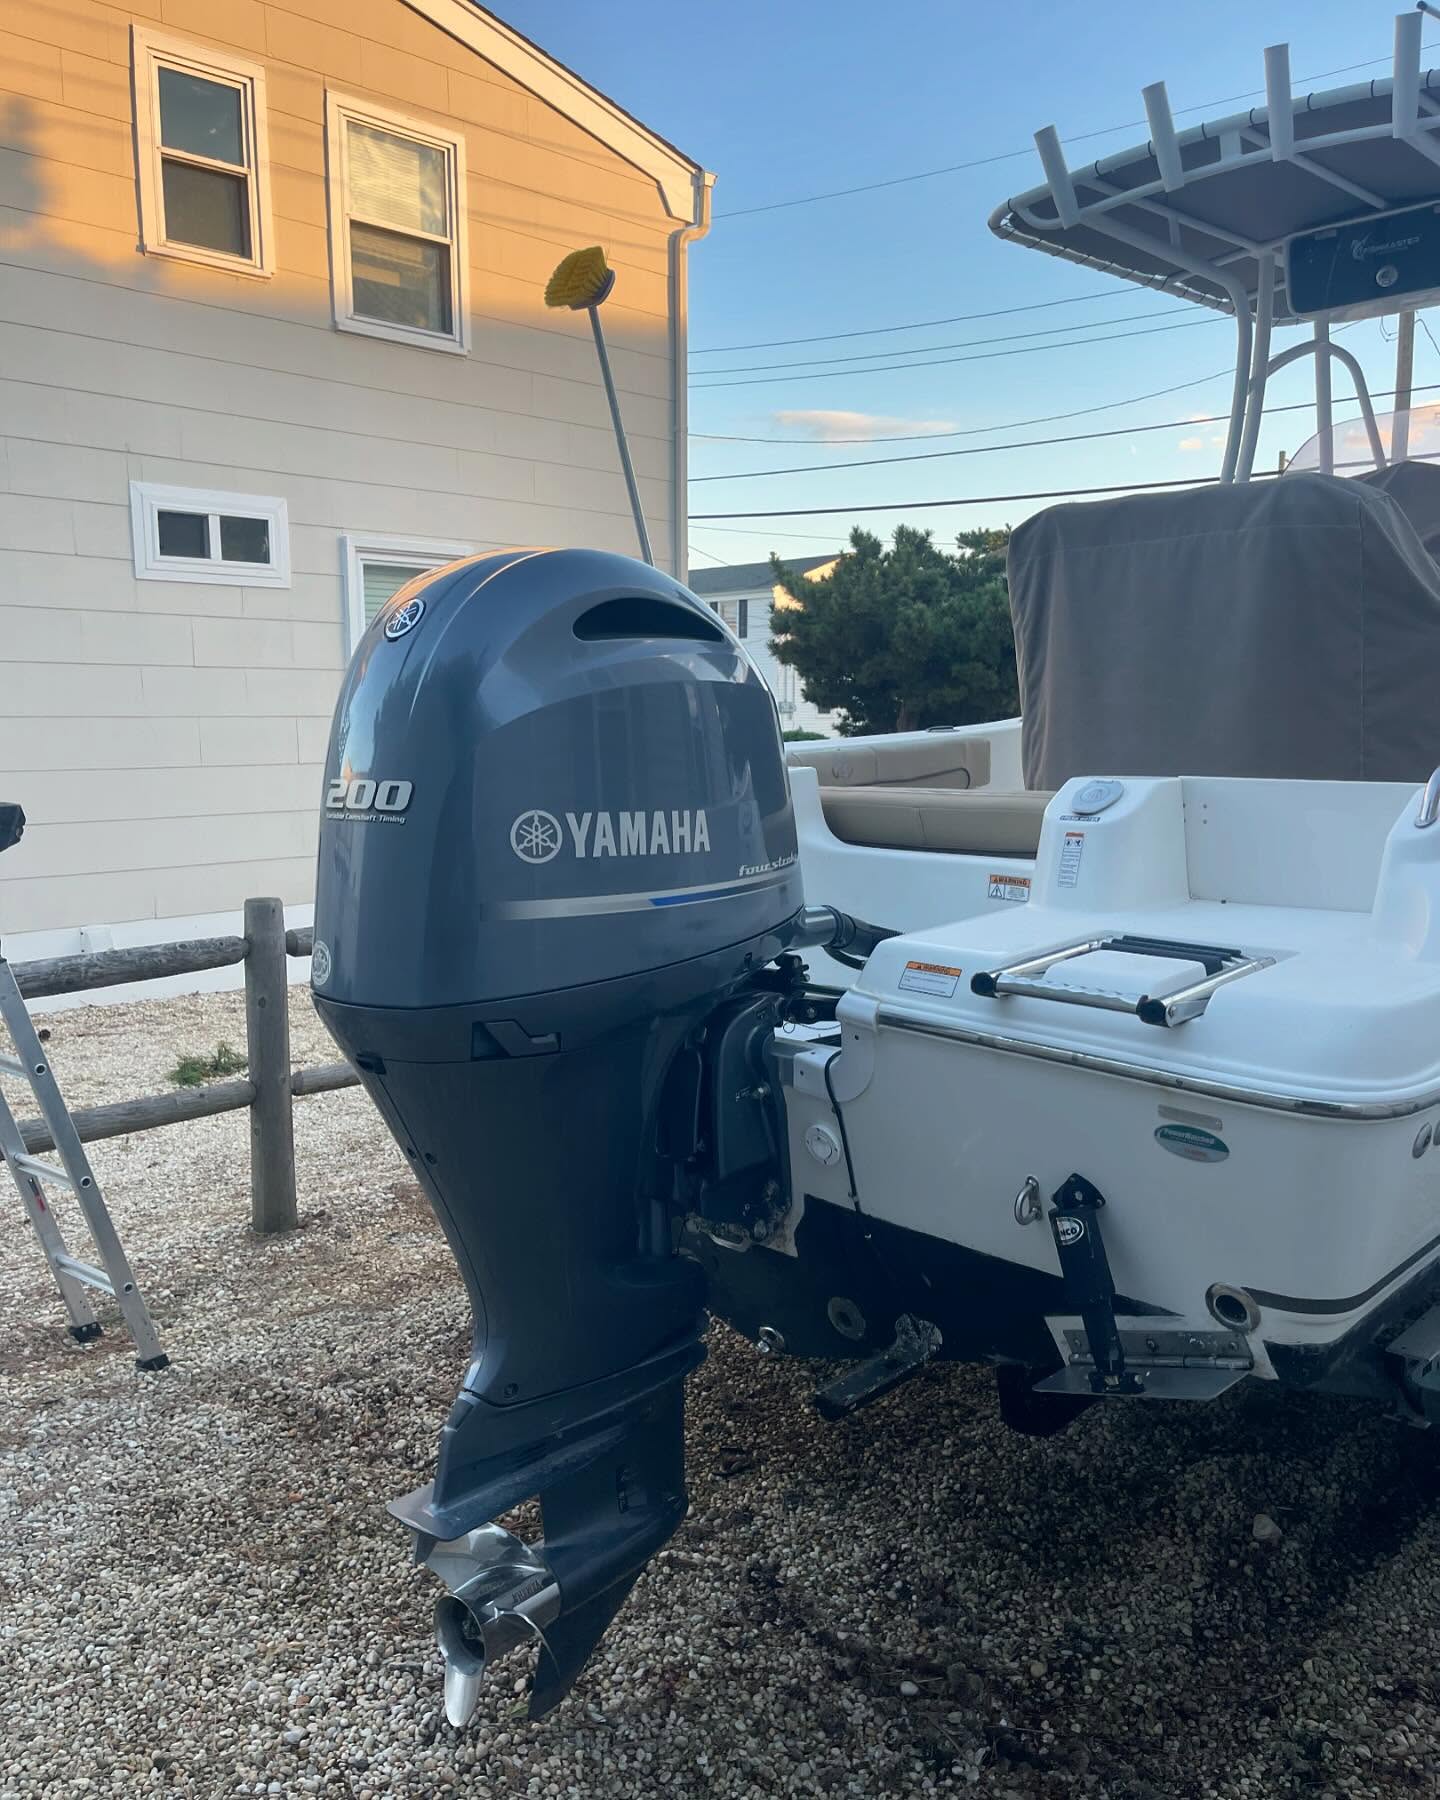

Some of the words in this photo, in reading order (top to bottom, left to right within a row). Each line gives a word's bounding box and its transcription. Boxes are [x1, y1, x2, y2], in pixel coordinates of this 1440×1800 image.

[326, 779, 413, 811] 200
[379, 814, 407, 825] Timing
[566, 809, 711, 858] YAMAHA
[739, 863, 770, 878] four
